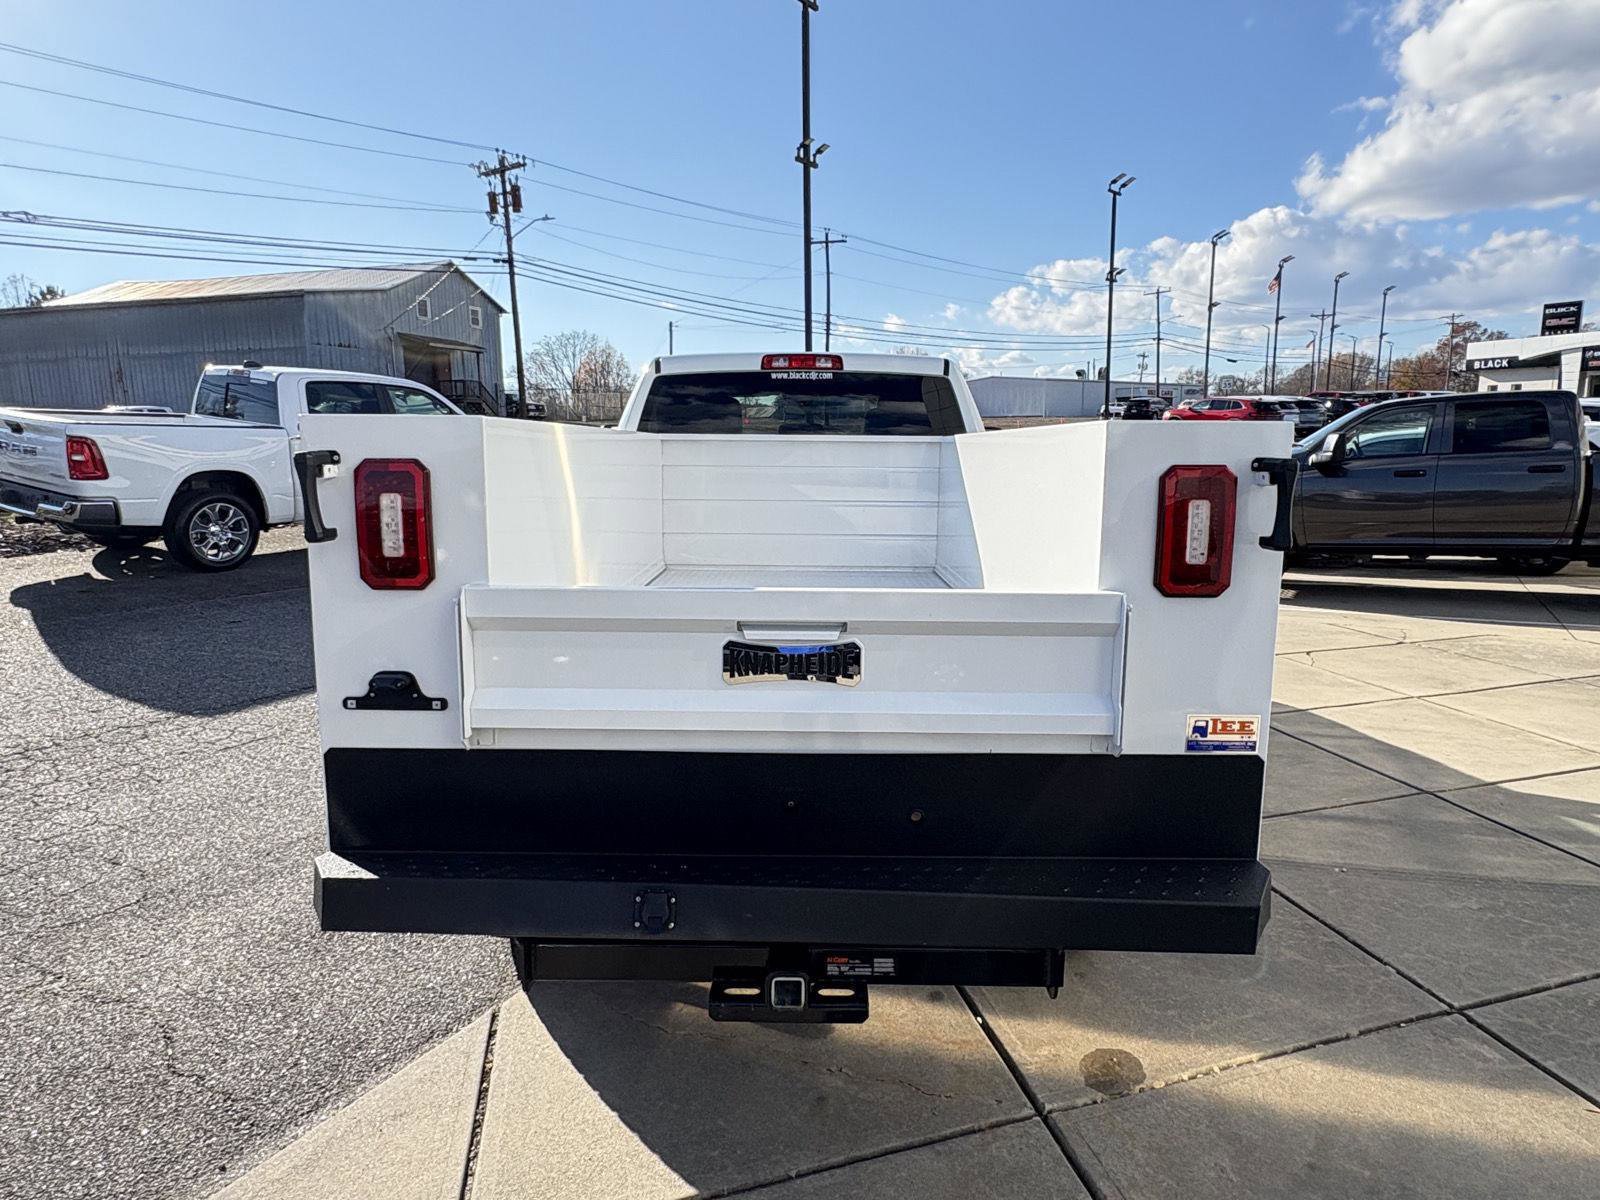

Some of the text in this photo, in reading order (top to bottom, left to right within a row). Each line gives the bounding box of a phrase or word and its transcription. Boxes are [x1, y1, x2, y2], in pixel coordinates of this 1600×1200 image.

[1545, 306, 1578, 314] BUICK
[1545, 317, 1576, 326] GMC
[1473, 359, 1509, 369] BLACK
[771, 371, 833, 380] www.blackcdjr.com
[729, 647, 857, 679] KNAPHEIDE
[1209, 718, 1255, 735] LEE
